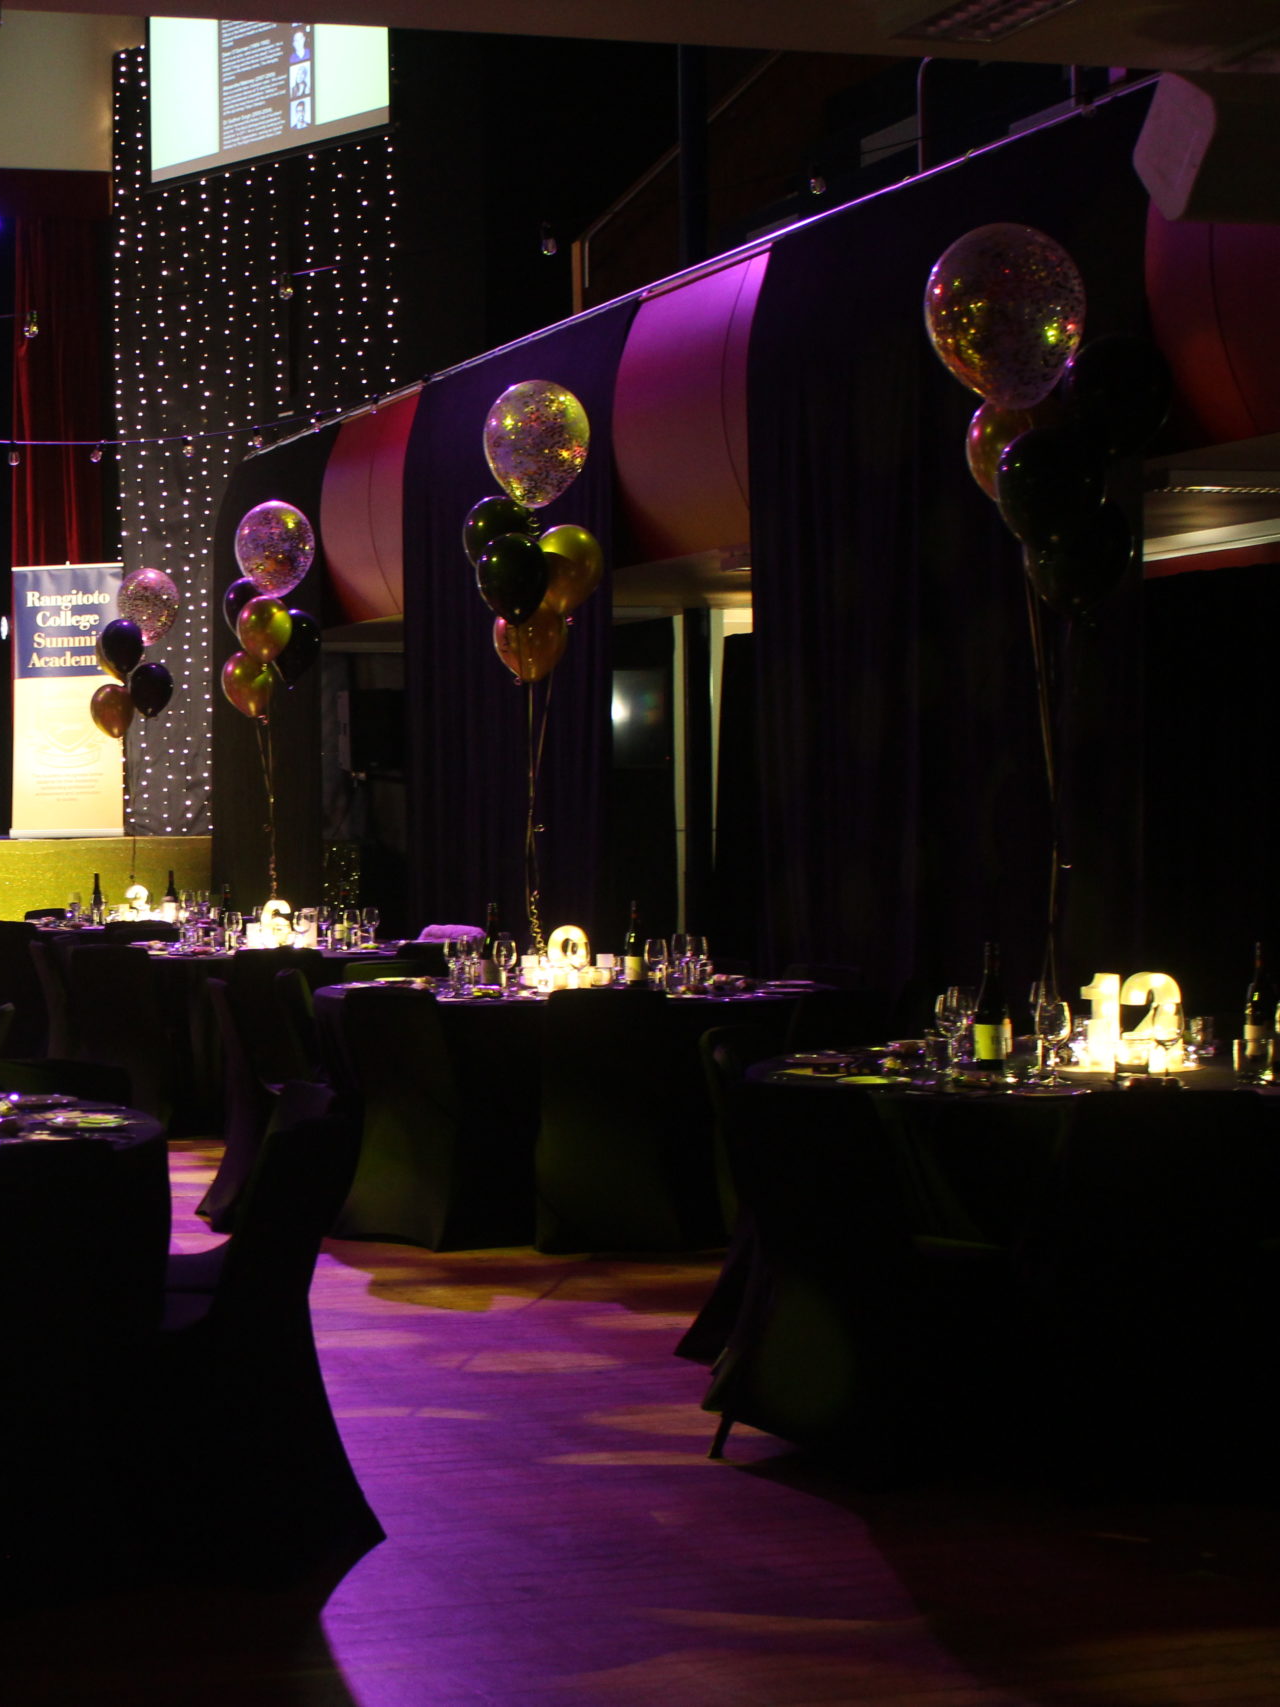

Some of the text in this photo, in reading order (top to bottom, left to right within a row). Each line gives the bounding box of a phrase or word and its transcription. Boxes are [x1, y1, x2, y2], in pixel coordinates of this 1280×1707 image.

[26, 589, 111, 611] Rangitoto
[35, 610, 100, 631] College
[33, 630, 97, 649] Summi
[27, 650, 102, 671] Academ
[261, 899, 291, 947] 6
[1081, 971, 1183, 1072] 12
